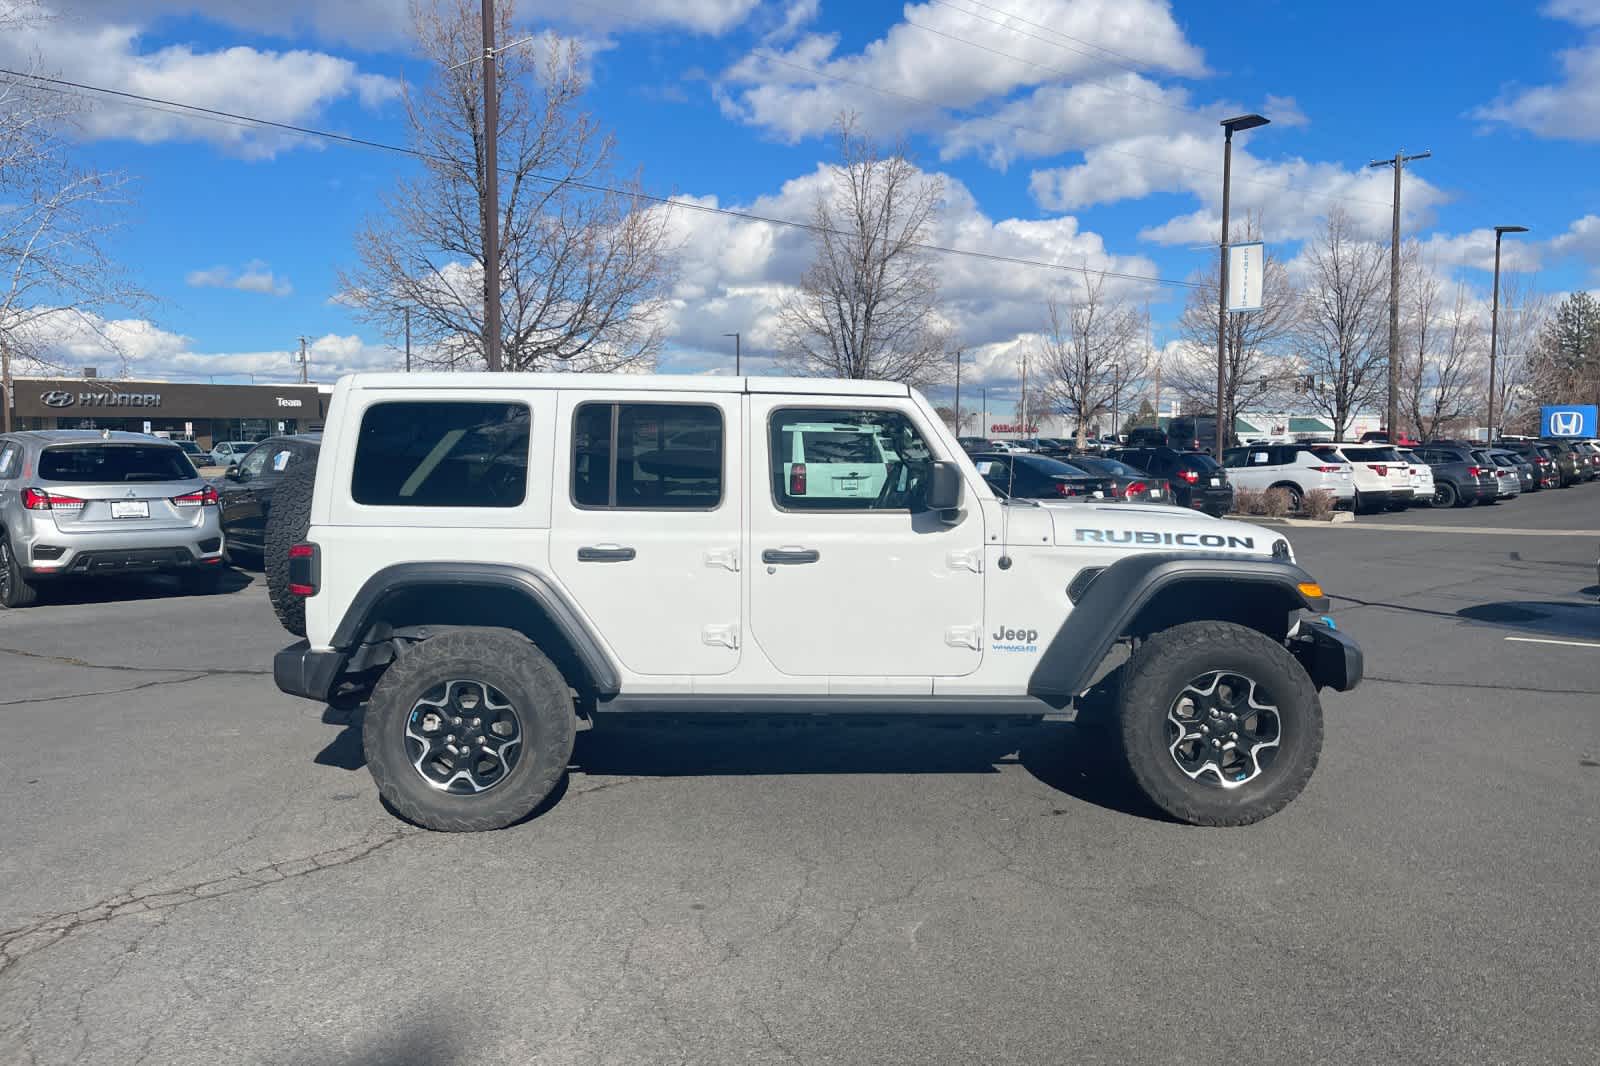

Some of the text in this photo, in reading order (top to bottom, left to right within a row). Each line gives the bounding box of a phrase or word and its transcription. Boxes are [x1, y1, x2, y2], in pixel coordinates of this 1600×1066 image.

[79, 392, 161, 407] HYUNDAI
[275, 397, 302, 407] Team
[1074, 528, 1255, 549] RUBICON
[992, 625, 1038, 644] Jeep
